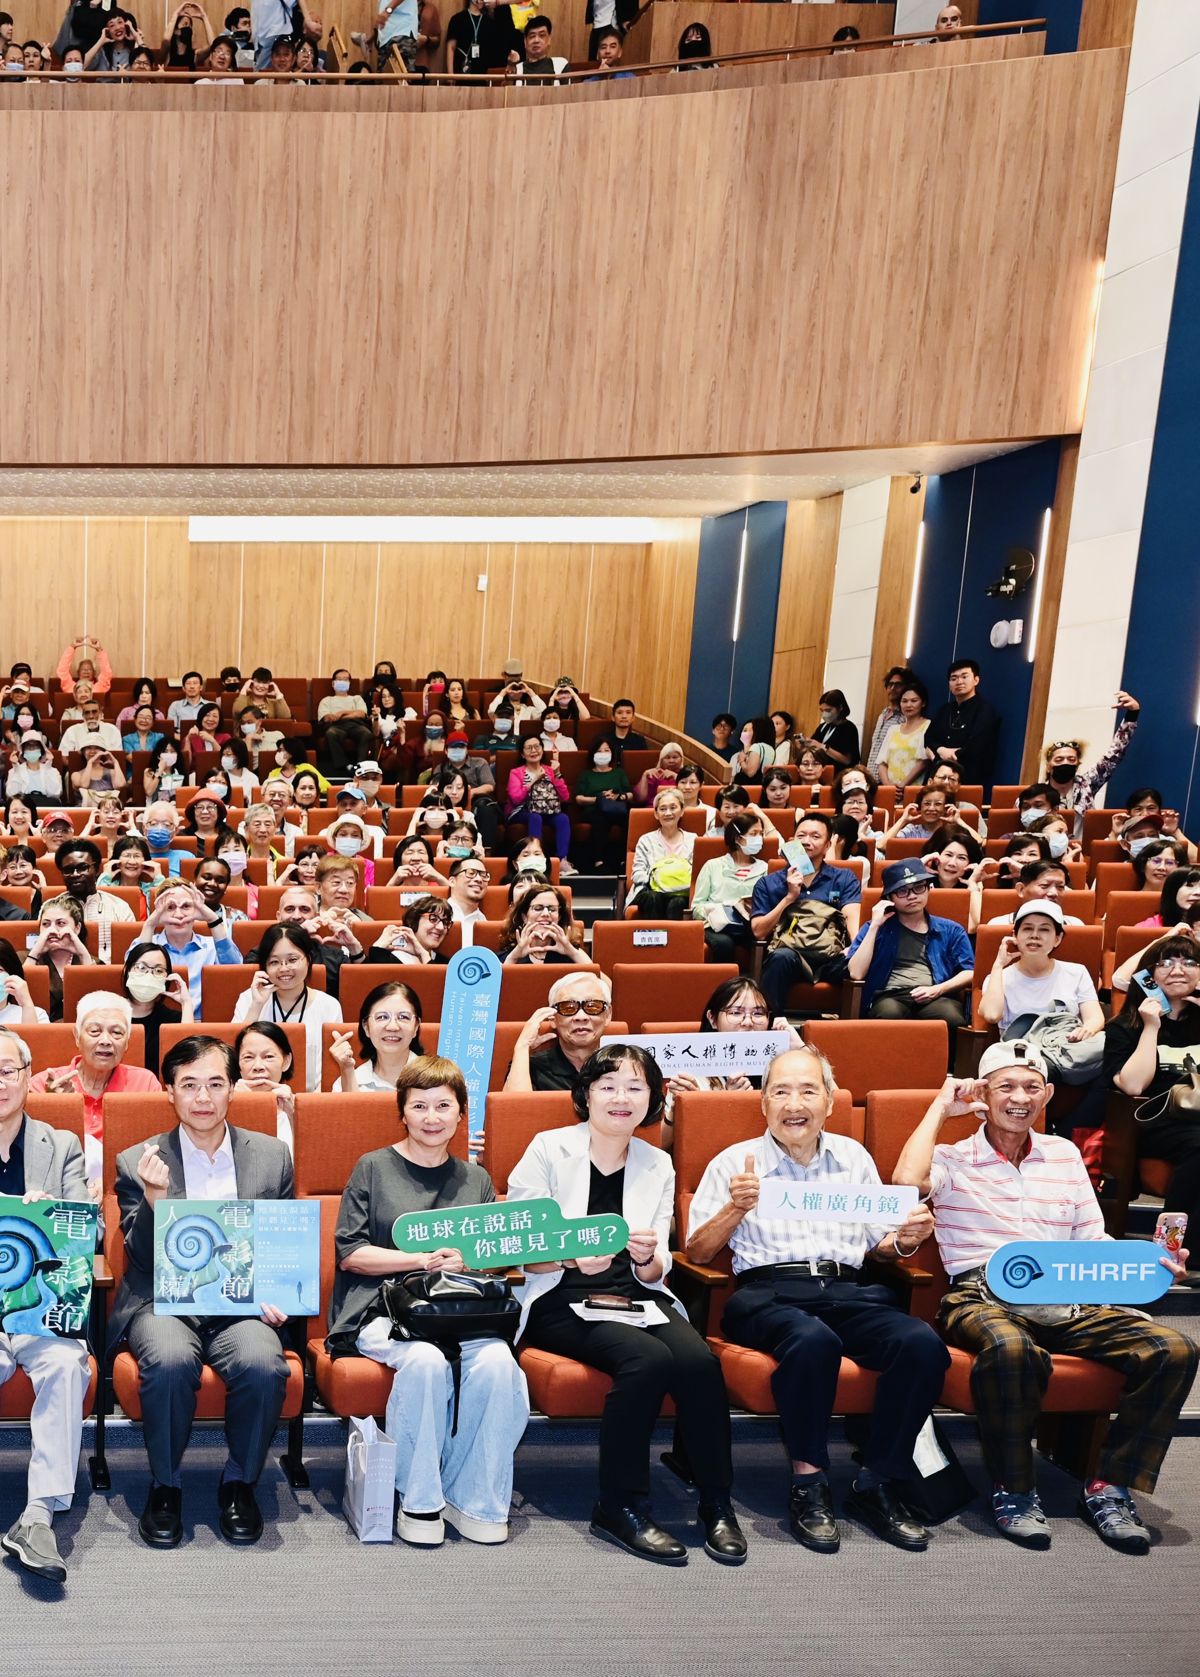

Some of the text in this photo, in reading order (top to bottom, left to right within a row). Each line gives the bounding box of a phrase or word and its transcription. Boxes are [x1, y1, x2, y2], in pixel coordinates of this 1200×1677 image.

[466, 993, 491, 1139] 臺灣國際人權電
[777, 1191, 900, 1214] 人權廣角鏡
[474, 1225, 618, 1259] 你聽見了嗎？
[1051, 1263, 1156, 1281] TIHRFF
